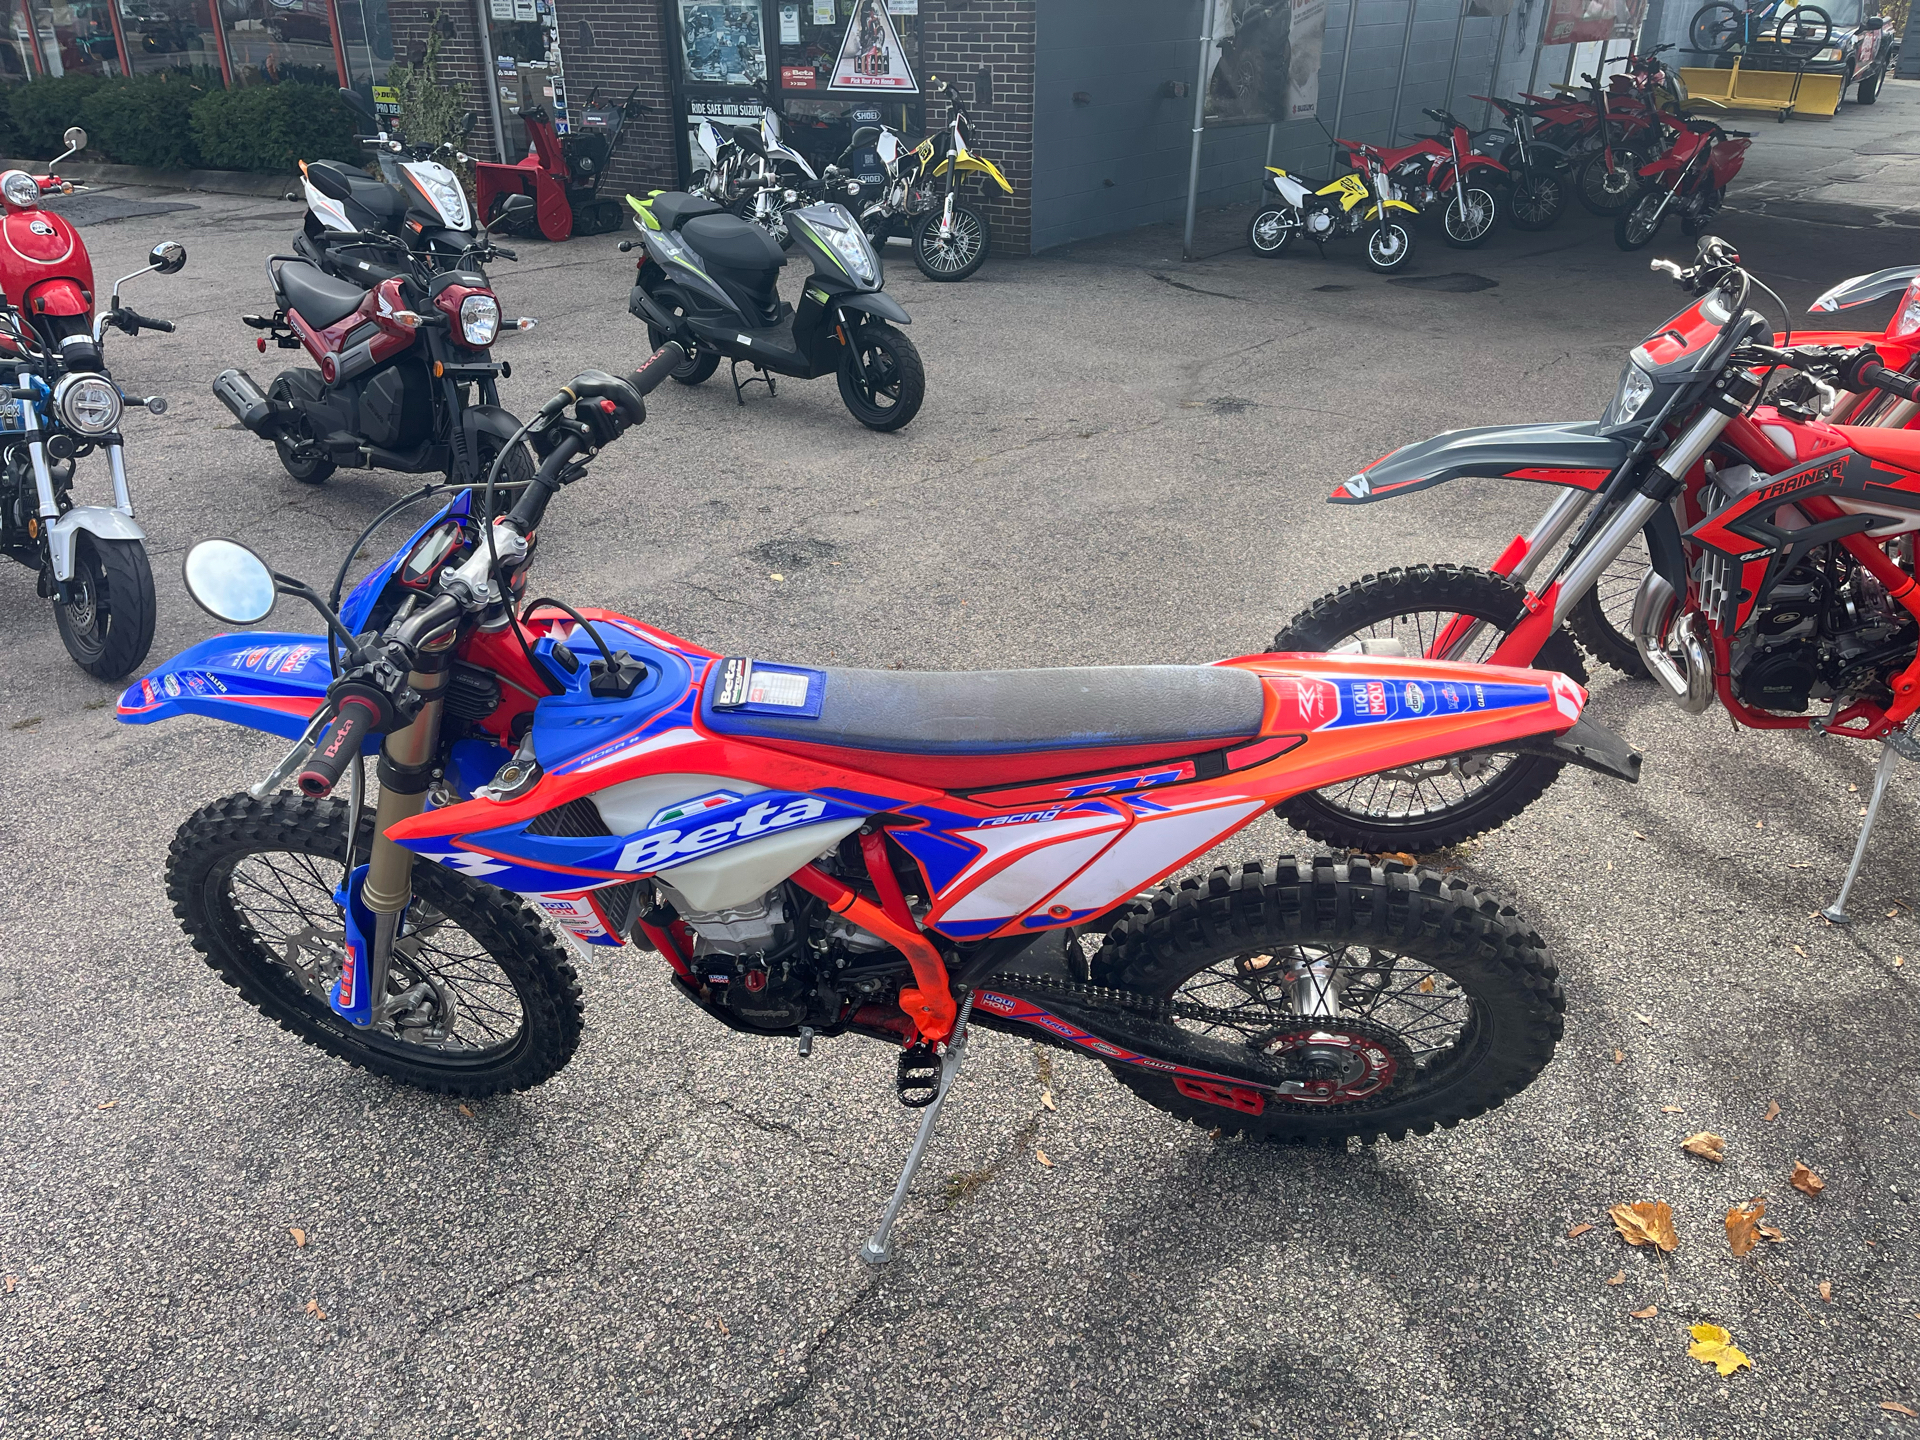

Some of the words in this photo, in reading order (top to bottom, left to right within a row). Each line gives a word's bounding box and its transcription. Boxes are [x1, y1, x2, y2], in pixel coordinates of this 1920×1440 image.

[861, 77, 871, 85] Your
[376, 104, 388, 113] PRO
[389, 105, 401, 114] DEA
[691, 103, 706, 114] RIDE
[706, 104, 721, 115] SAFE
[722, 104, 738, 115] WITH
[739, 105, 762, 116] SUZUKI
[856, 112, 878, 120] SHOEI
[860, 175, 881, 185] SHOEI
[1757, 461, 1844, 501] TRAINER
[1740, 547, 1777, 562] Beta
[282, 646, 312, 672] MOLY
[293, 647, 322, 672] LIQUI
[206, 672, 228, 694] GALFER
[719, 659, 737, 704] Beta
[731, 659, 743, 703] motorcycles
[1315, 683, 1325, 719] racing
[1353, 684, 1370, 714] LIQUI
[1368, 684, 1385, 713] MOLY
[1409, 684, 1419, 710] domino
[1443, 683, 1459, 710] VERTEX
[1474, 684, 1486, 708] GALFER
[323, 719, 354, 758] Beta
[580, 742, 626, 765] RIDER
[977, 804, 1064, 828] racing
[614, 797, 827, 872] Beta
[982, 999, 1012, 1013] MOLY
[984, 993, 1016, 1007] LIQUI
[315, 1018, 345, 1038] EXCEL
[1040, 1016, 1074, 1035] VERTEX
[1143, 1060, 1177, 1070] GALFER
